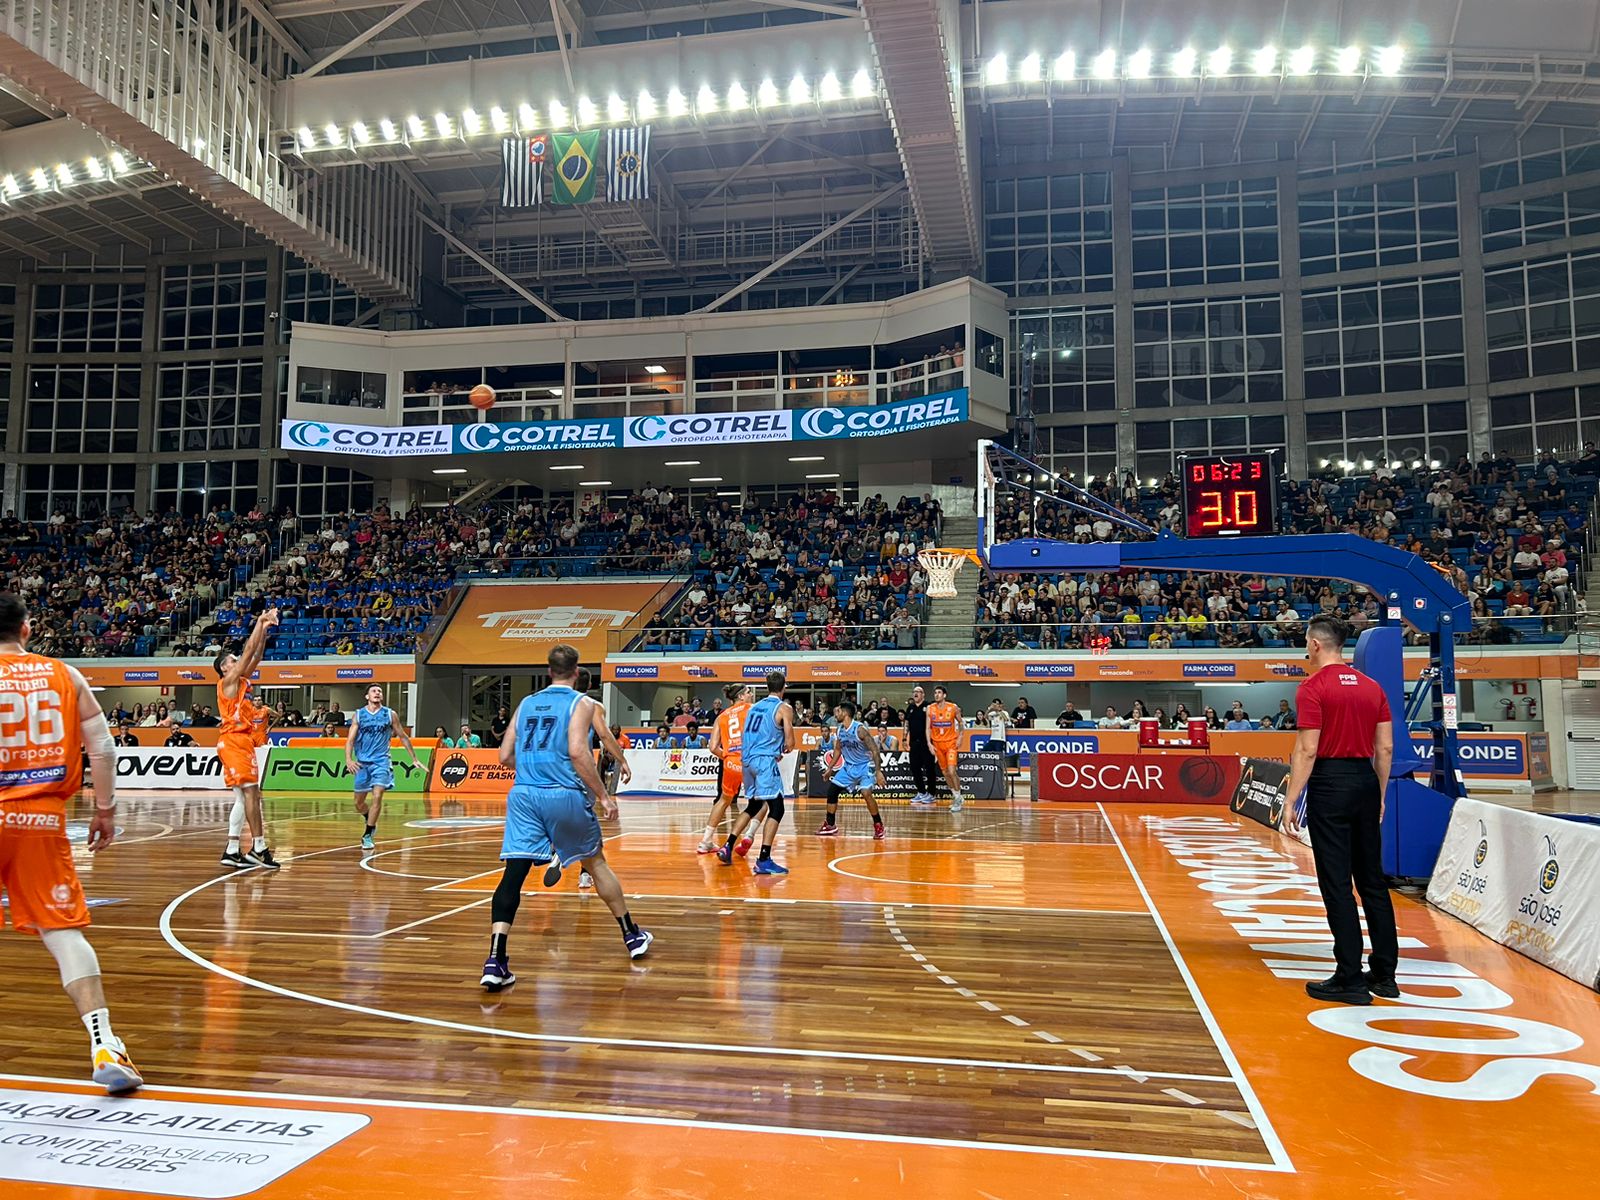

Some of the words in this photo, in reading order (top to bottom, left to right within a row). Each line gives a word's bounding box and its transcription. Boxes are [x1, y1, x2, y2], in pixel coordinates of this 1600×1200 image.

[847, 396, 960, 430] COTREL
[502, 423, 616, 446] COTREL
[669, 414, 787, 435] COTREL
[850, 426, 898, 438] ORTOPEDIA
[906, 415, 960, 432] FISIOTERAPIA
[332, 429, 448, 447] COTREL
[504, 443, 550, 452] ORTOPEDIA
[559, 441, 616, 450] FISIOTERAPIA
[670, 434, 720, 443] ORTOPEDIA
[729, 431, 787, 441] FISIOTERAPIA
[334, 446, 387, 455] ORTOPEDIA
[1193, 461, 1261, 482] 06:23
[1201, 490, 1257, 526] 3.0
[0, 690, 65, 747] 26
[523, 716, 558, 752] 77
[974, 741, 1030, 754] FMA
[1035, 741, 1094, 754] CONDE
[1457, 746, 1517, 759] ONDE
[116, 753, 224, 776] overti
[442, 767, 466, 775] FPB
[470, 771, 484, 780] DE
[1052, 762, 1165, 791] OSCAR
[6, 812, 61, 827] COTREL
[96, 1111, 159, 1126] DE
[150, 1114, 324, 1138] ATLETAS
[1, 1132, 122, 1154] COMITÊ
[114, 1143, 270, 1166] BRASILEIRO
[60, 1153, 188, 1173] CLUBES
